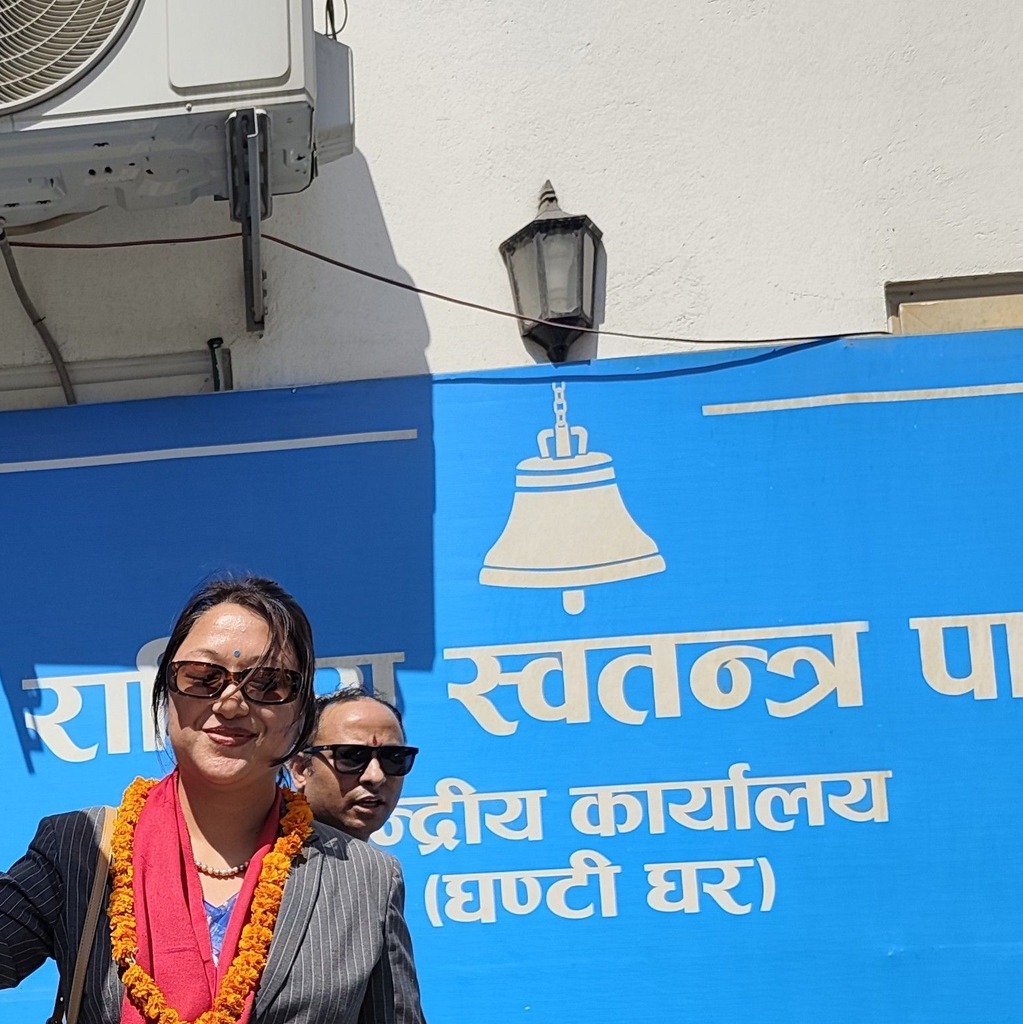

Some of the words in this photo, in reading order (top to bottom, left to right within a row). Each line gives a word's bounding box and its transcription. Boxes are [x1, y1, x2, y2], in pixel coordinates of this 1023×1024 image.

[443, 621, 869, 736] स्वतन्त्र
[370, 778, 547, 855] न्द्रीय
[570, 763, 892, 836] कार्यालय
[425, 849, 622, 926] (घण्टी
[644, 858, 776, 915] घर)
